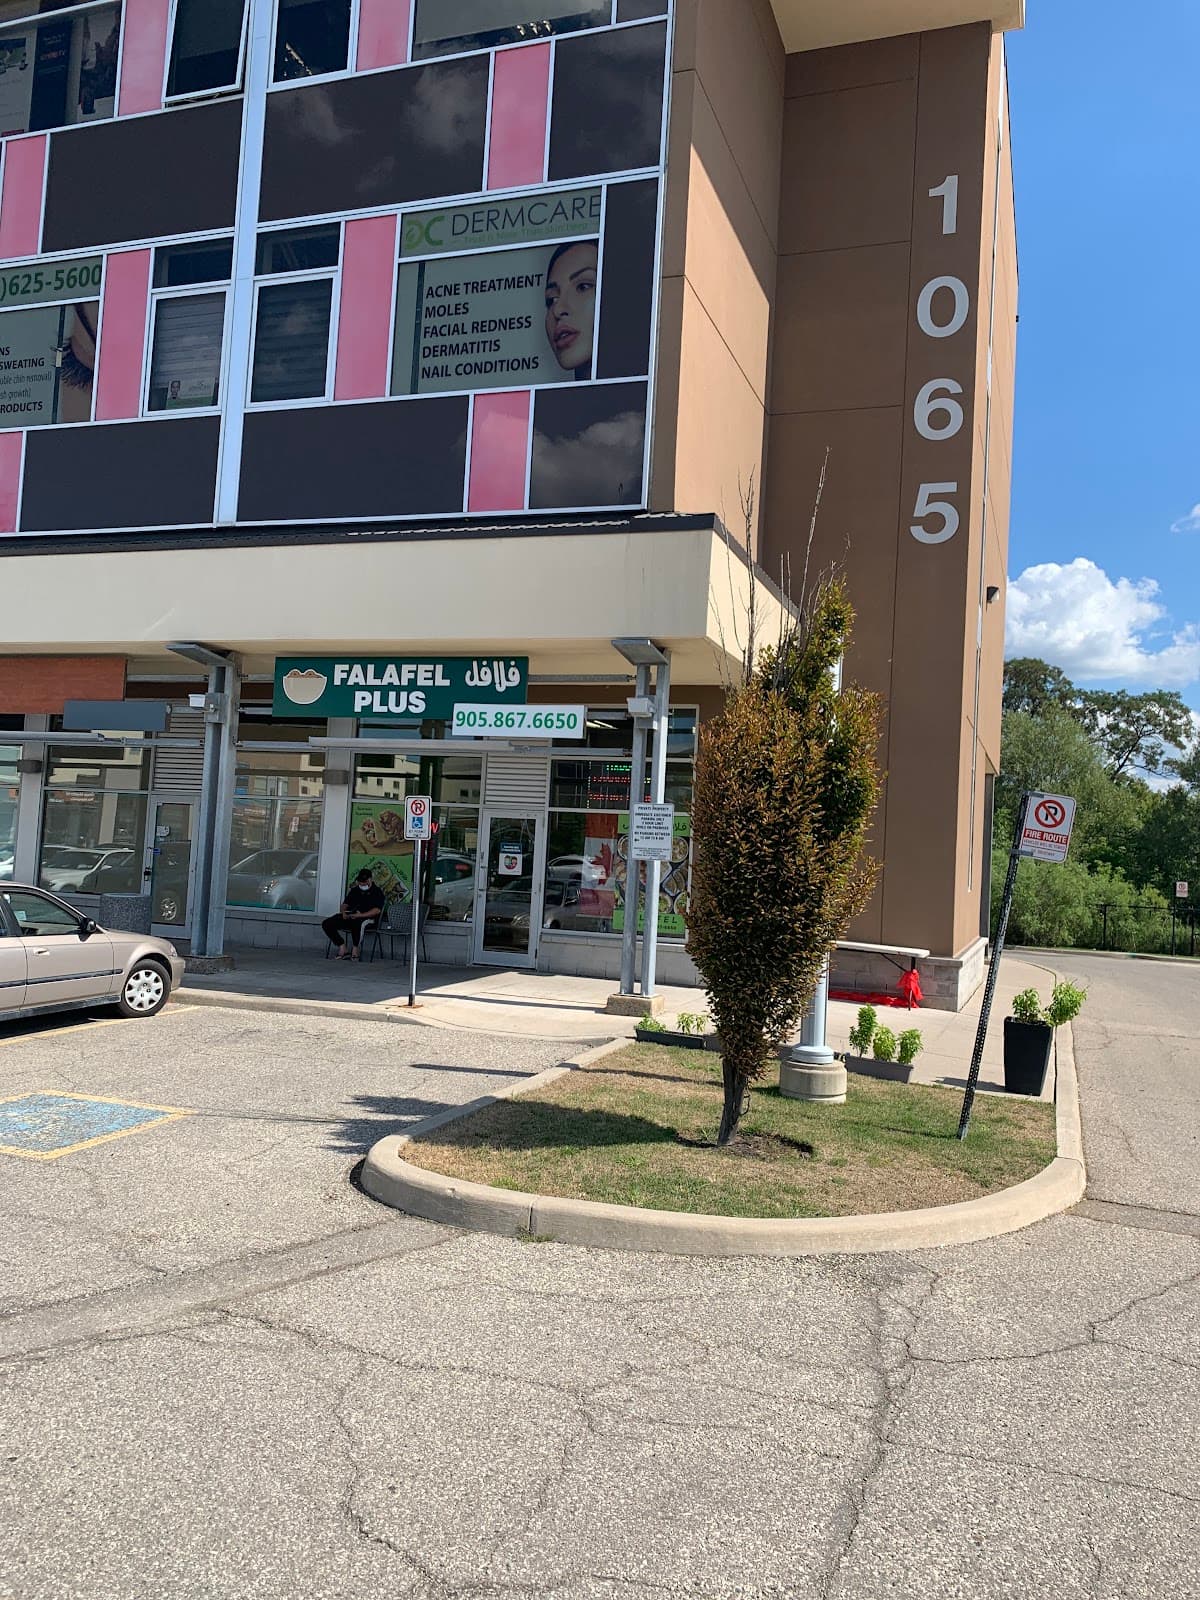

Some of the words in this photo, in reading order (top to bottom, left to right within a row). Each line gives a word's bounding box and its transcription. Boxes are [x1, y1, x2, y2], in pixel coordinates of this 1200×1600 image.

[452, 195, 601, 235] DERMCARE
[426, 282, 460, 299] ACNE
[463, 273, 543, 295] TREATMENT
[424, 302, 469, 319] MOLES
[423, 321, 468, 339] FACIAL
[471, 316, 532, 333] REDNESS
[422, 339, 501, 358] DERMATITIS
[421, 364, 452, 380] NAIL
[455, 356, 539, 376] CONDITIONS
[333, 663, 451, 687] FALAFEL
[464, 660, 521, 693] فلافل
[354, 691, 426, 713] PLUS
[455, 710, 578, 731] 905.867.6650
[1025, 829, 1042, 839] FIRE
[1043, 831, 1068, 844] ROUTE
